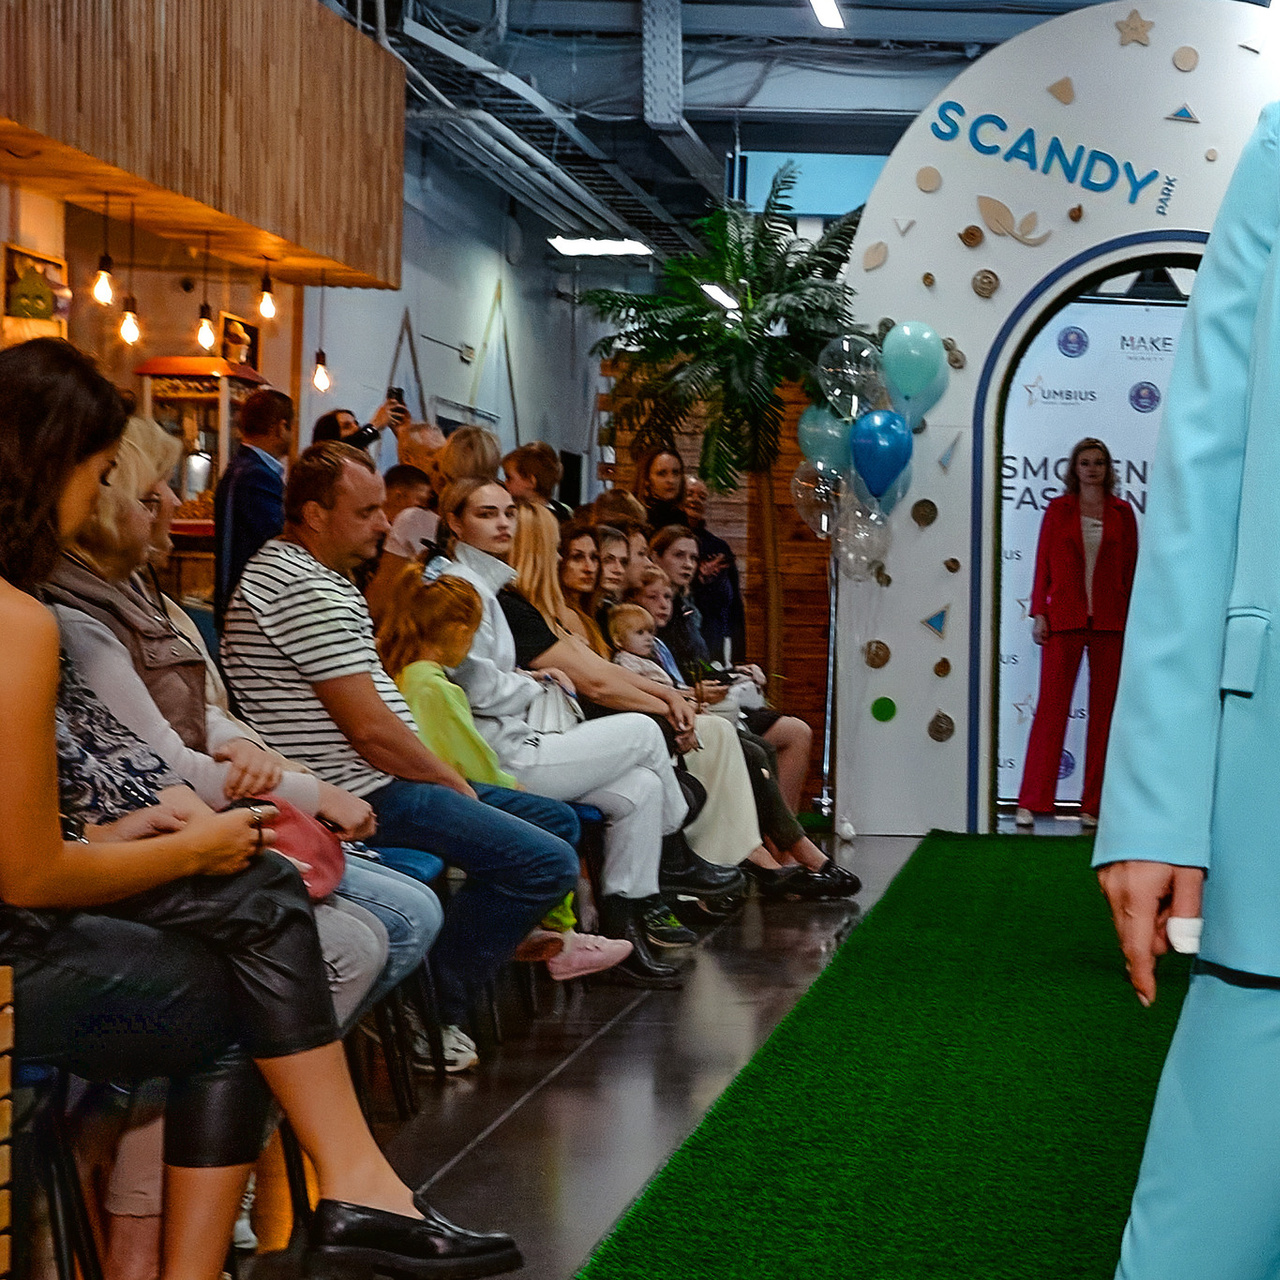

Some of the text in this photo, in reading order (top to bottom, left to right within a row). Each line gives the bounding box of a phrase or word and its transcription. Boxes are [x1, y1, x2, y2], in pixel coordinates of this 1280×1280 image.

[931, 100, 1159, 204] SCANDY
[1156, 174, 1179, 216] PARK
[1120, 335, 1173, 352] MAKE
[1041, 389, 1097, 401] UMBIUS
